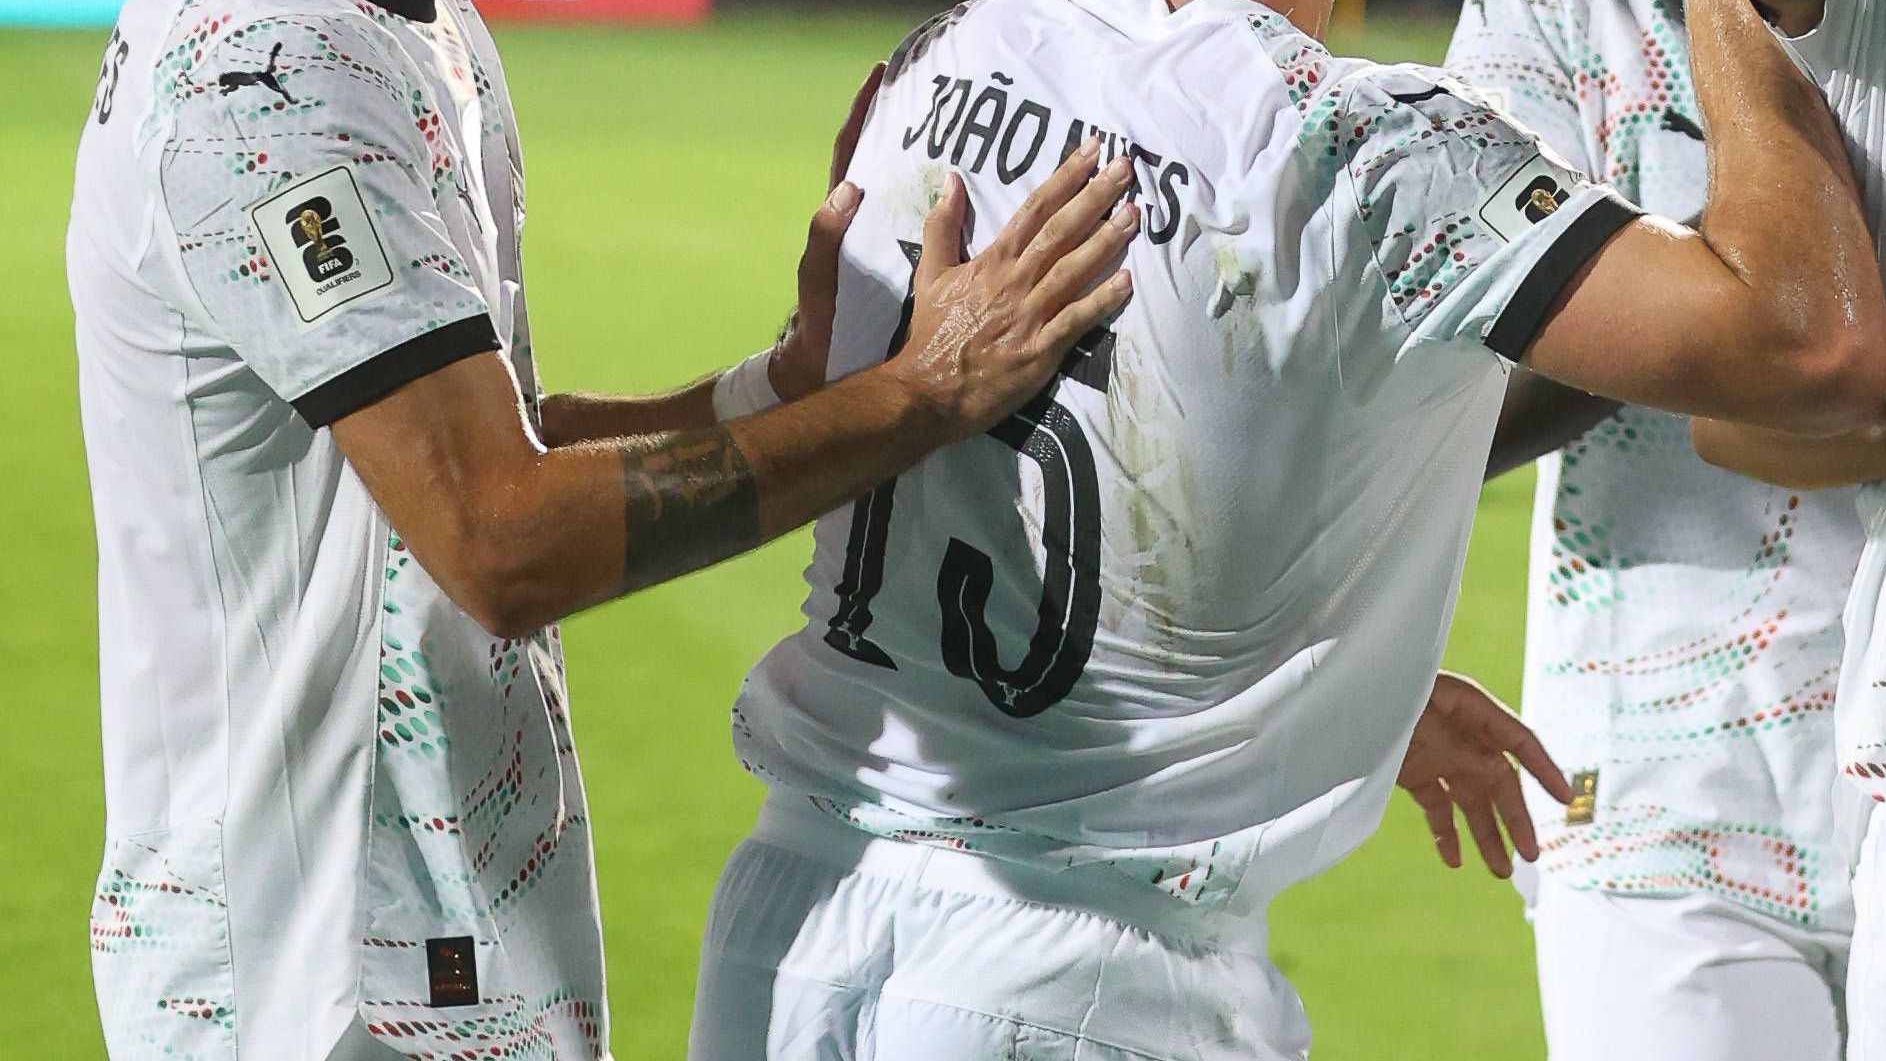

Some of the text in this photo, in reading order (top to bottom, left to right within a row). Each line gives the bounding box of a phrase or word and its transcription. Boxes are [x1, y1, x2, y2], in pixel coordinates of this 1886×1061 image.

[902, 71, 1052, 186] JOÃO
[317, 257, 344, 275] FIFA
[316, 270, 362, 296] QUALIFIERS
